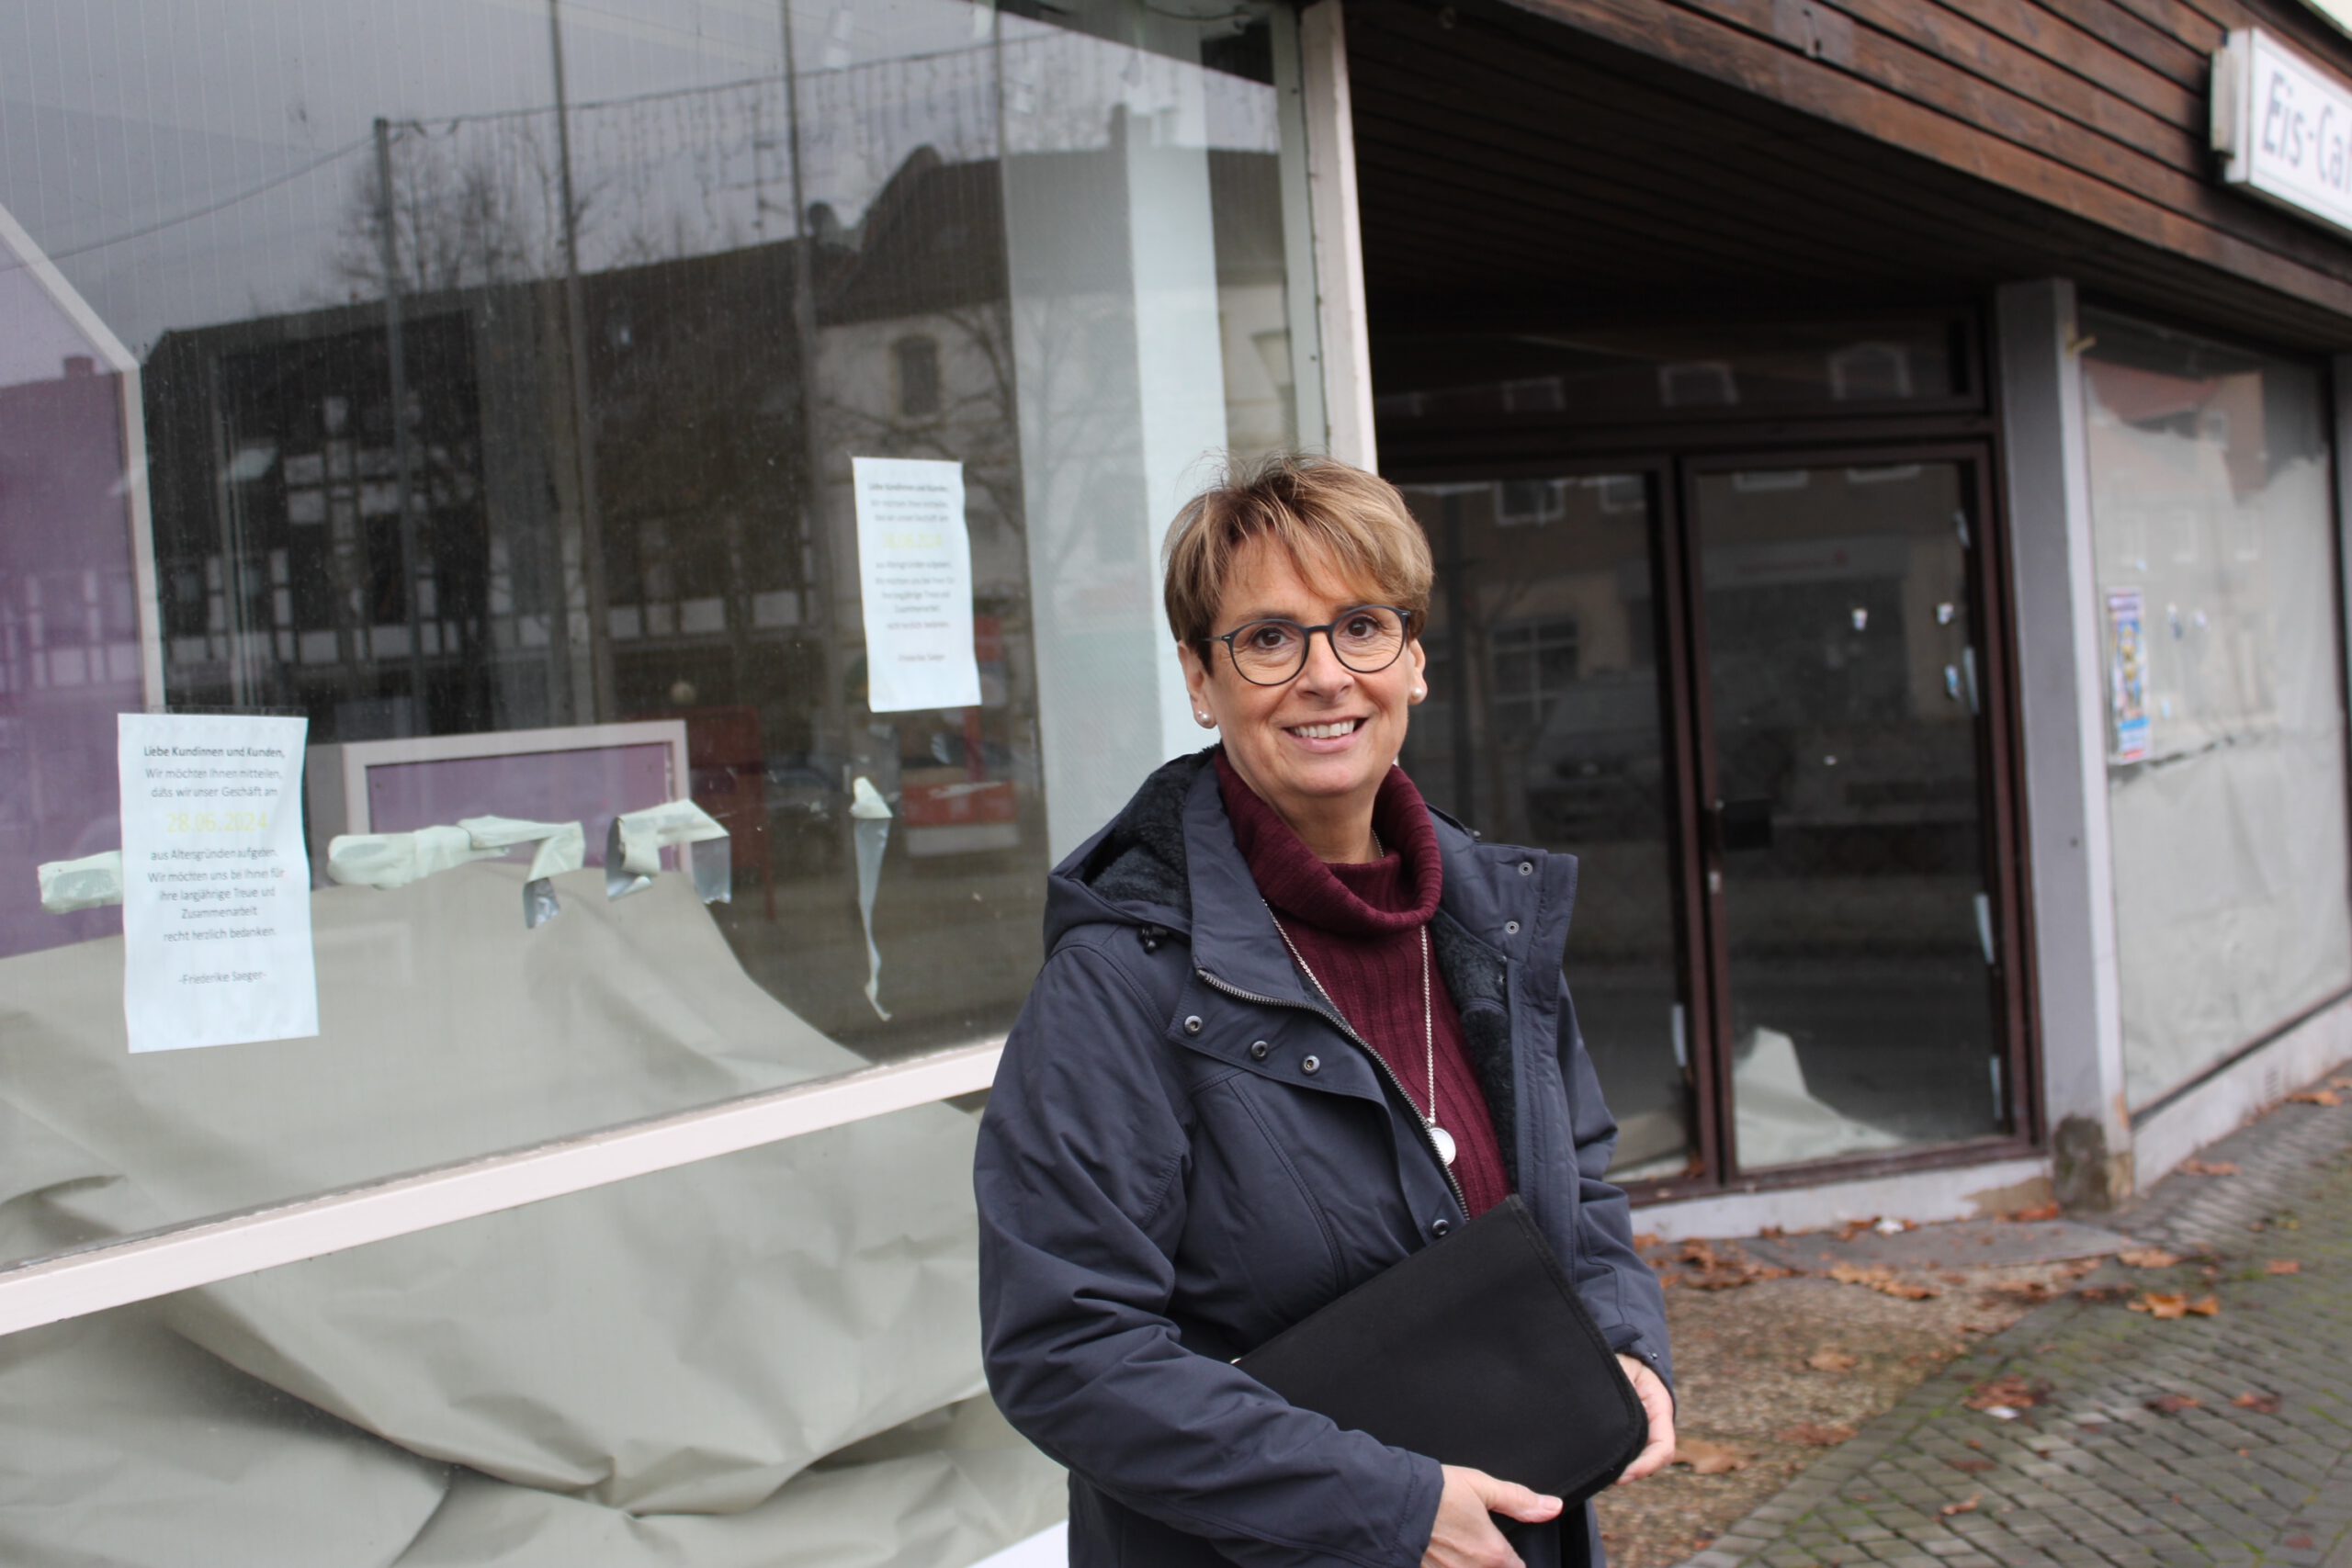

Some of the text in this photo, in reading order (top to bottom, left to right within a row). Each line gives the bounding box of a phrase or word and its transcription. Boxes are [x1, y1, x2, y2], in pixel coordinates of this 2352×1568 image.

[143, 746, 286, 759] Liebe Kundinnen und Kunden,
[145, 768, 163, 779] Wir
[165, 768, 208, 779] möchten
[209, 768, 238, 779] Ihnen
[175, 787, 192, 797] wir
[193, 788, 219, 797] unser
[221, 786, 263, 797] Geschäft
[265, 788, 278, 797] am
[151, 851, 169, 861] aus
[171, 848, 236, 862] Altersgründen
[147, 871, 166, 883] Wir
[168, 870, 209, 883] möchten
[210, 870, 228, 881] uns
[270, 866, 285, 878] für
[180, 887, 231, 903] langjährige
[233, 886, 258, 898] Treue
[261, 885, 276, 897] und
[181, 905, 257, 919] Zusammenarbeit
[164, 930, 189, 942] recht
[191, 928, 227, 941] herzlich
